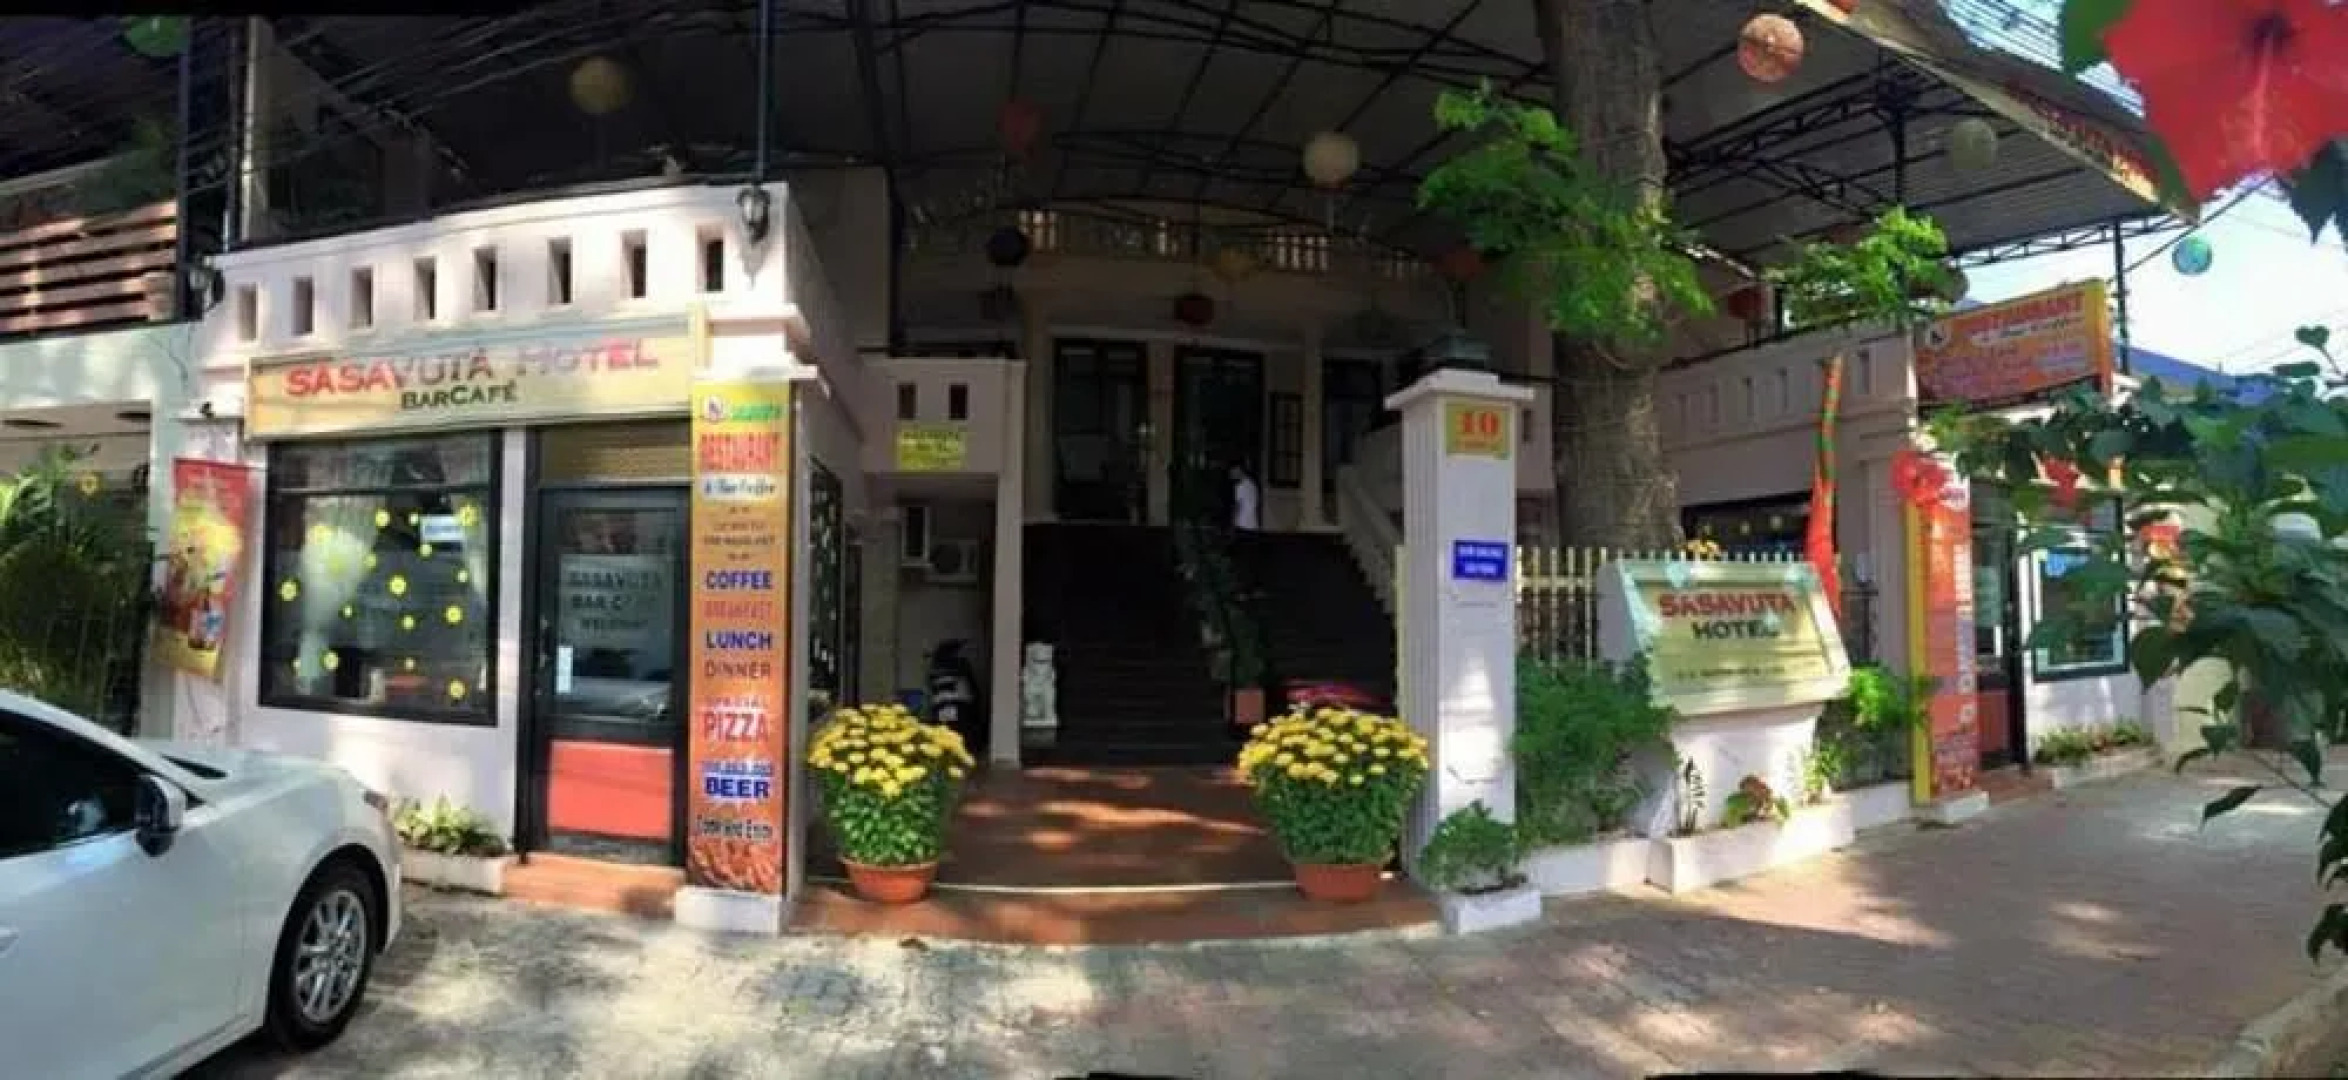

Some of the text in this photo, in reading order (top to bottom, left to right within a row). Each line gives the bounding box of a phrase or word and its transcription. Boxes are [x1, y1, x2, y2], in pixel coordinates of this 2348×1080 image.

[286, 338, 659, 396] SASAVUTA HOTEL
[1456, 411, 1500, 434] 10
[706, 570, 774, 592] COFFEE
[703, 600, 773, 620] BREAKFAST
[1658, 592, 1796, 618] SASAVUTA
[706, 630, 773, 649] LUNCH
[1691, 620, 1779, 640] HOTEL
[704, 661, 772, 678] DINNER
[703, 711, 769, 742] PIZZA
[705, 777, 770, 799] BEER
